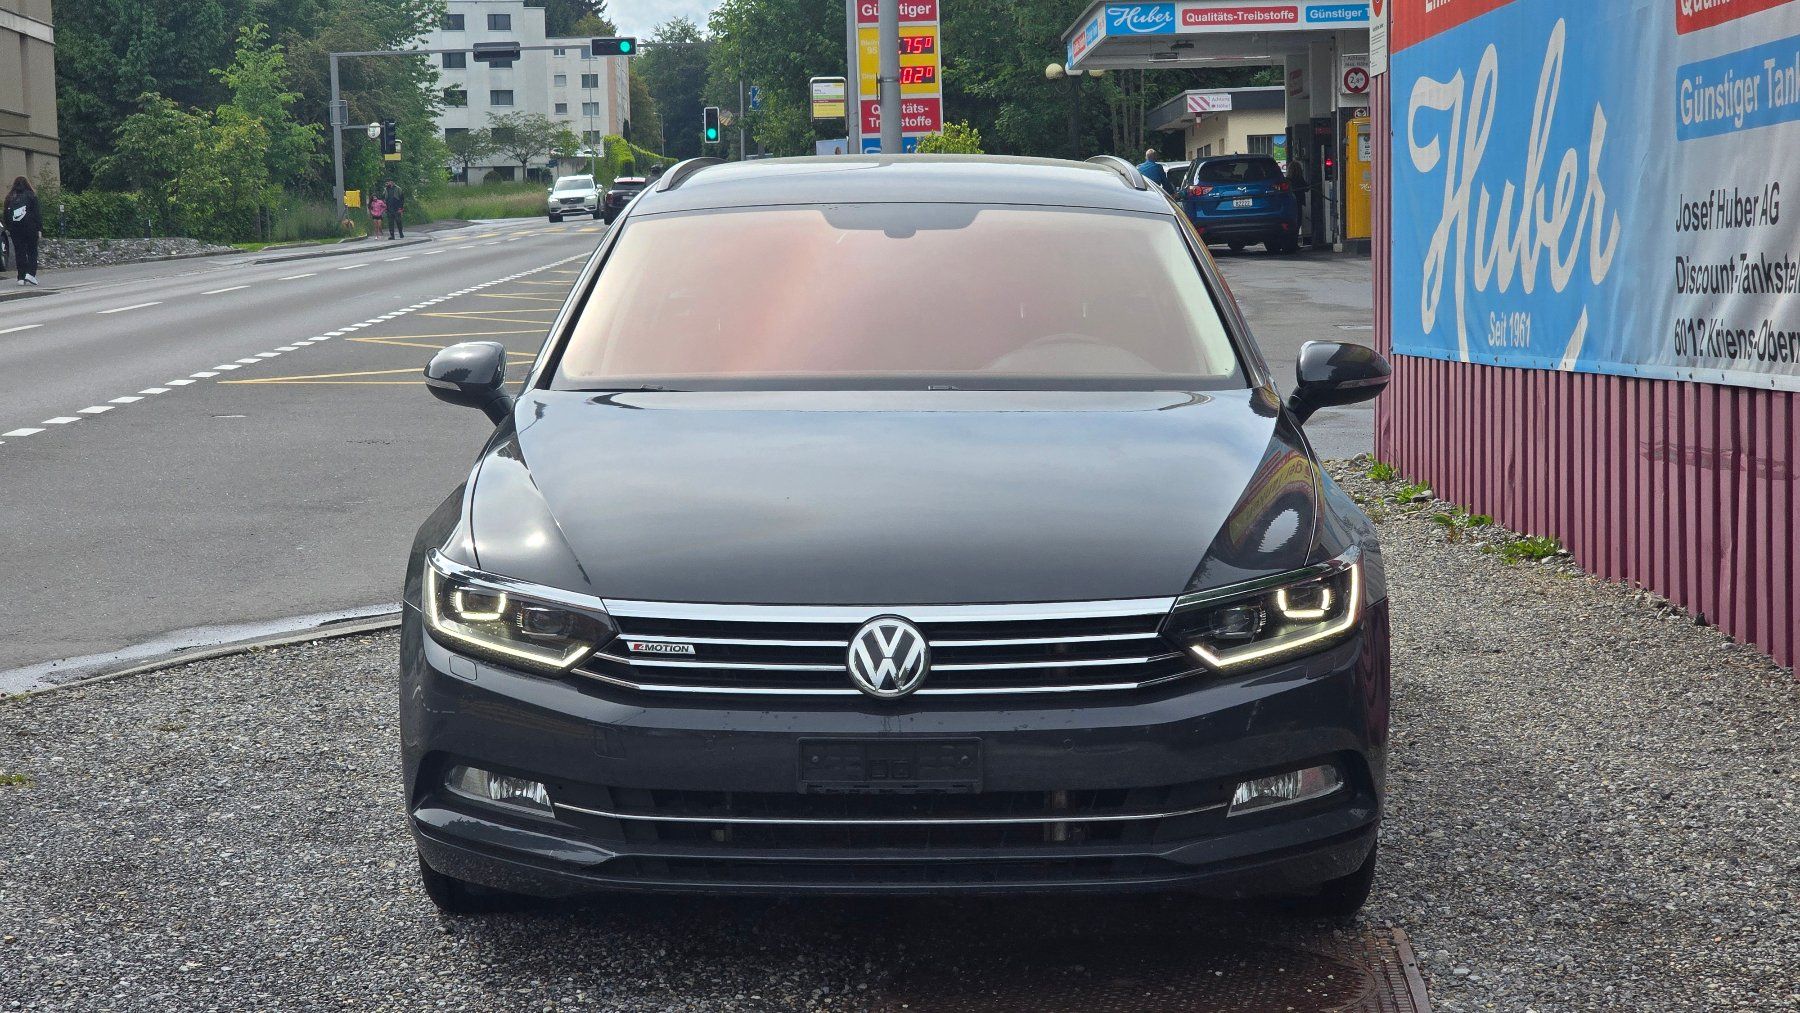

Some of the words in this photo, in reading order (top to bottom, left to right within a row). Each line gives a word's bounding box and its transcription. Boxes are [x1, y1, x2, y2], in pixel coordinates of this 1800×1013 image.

[862, 4, 932, 17] Gütiger
[1108, 6, 1173, 32] Huber
[1186, 11, 1295, 23] Qualitäts-Treibstoffe
[1309, 8, 1363, 19] Günstiger
[1680, 69, 1760, 128] Günstiger
[1407, 17, 1621, 362] Huber
[1676, 189, 1715, 233] Josef
[1716, 187, 1759, 229] Huber
[1759, 181, 1780, 226] AG
[1488, 311, 1507, 347] Seit
[1509, 311, 1531, 348] 1961
[1674, 318, 1706, 357] 6012
